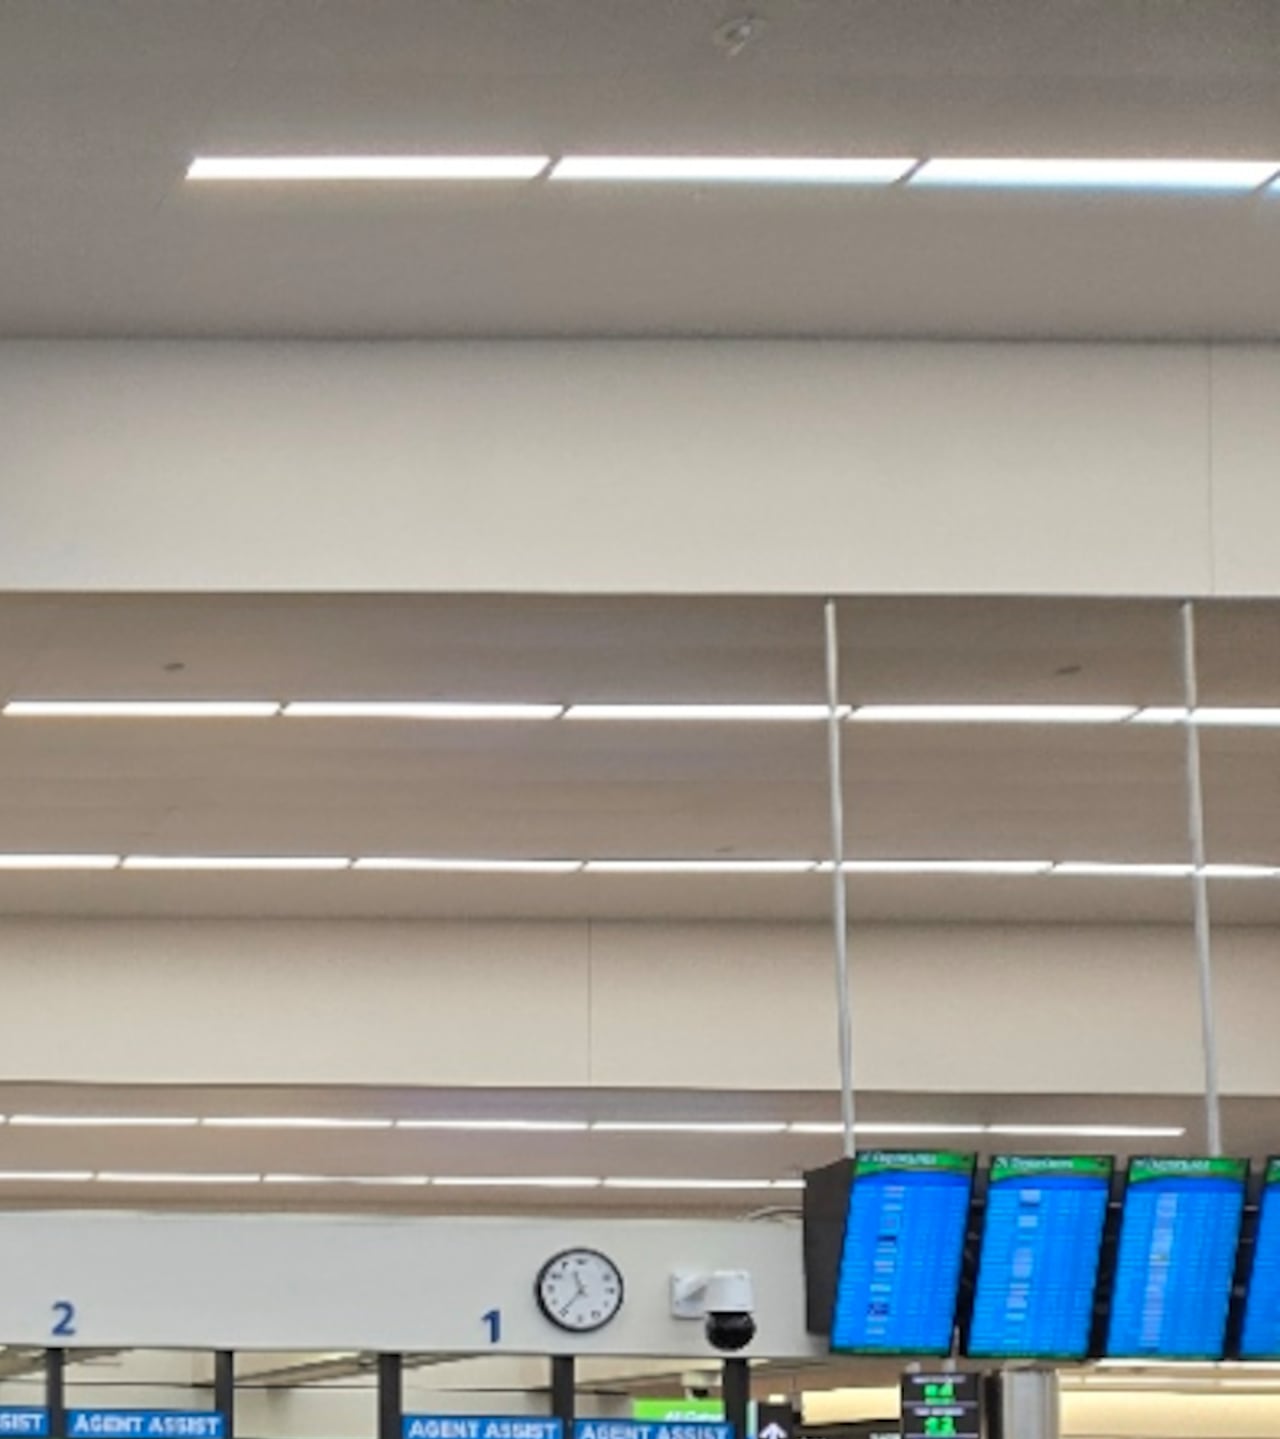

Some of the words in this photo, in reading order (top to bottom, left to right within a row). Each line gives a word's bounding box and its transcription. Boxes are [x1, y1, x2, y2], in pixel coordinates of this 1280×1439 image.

[51, 1301, 76, 1336] 2
[481, 1309, 501, 1344] 1
[74, 1414, 144, 1432] AGENT
[149, 1416, 220, 1435] ASSIST
[408, 1421, 479, 1439] AGENT
